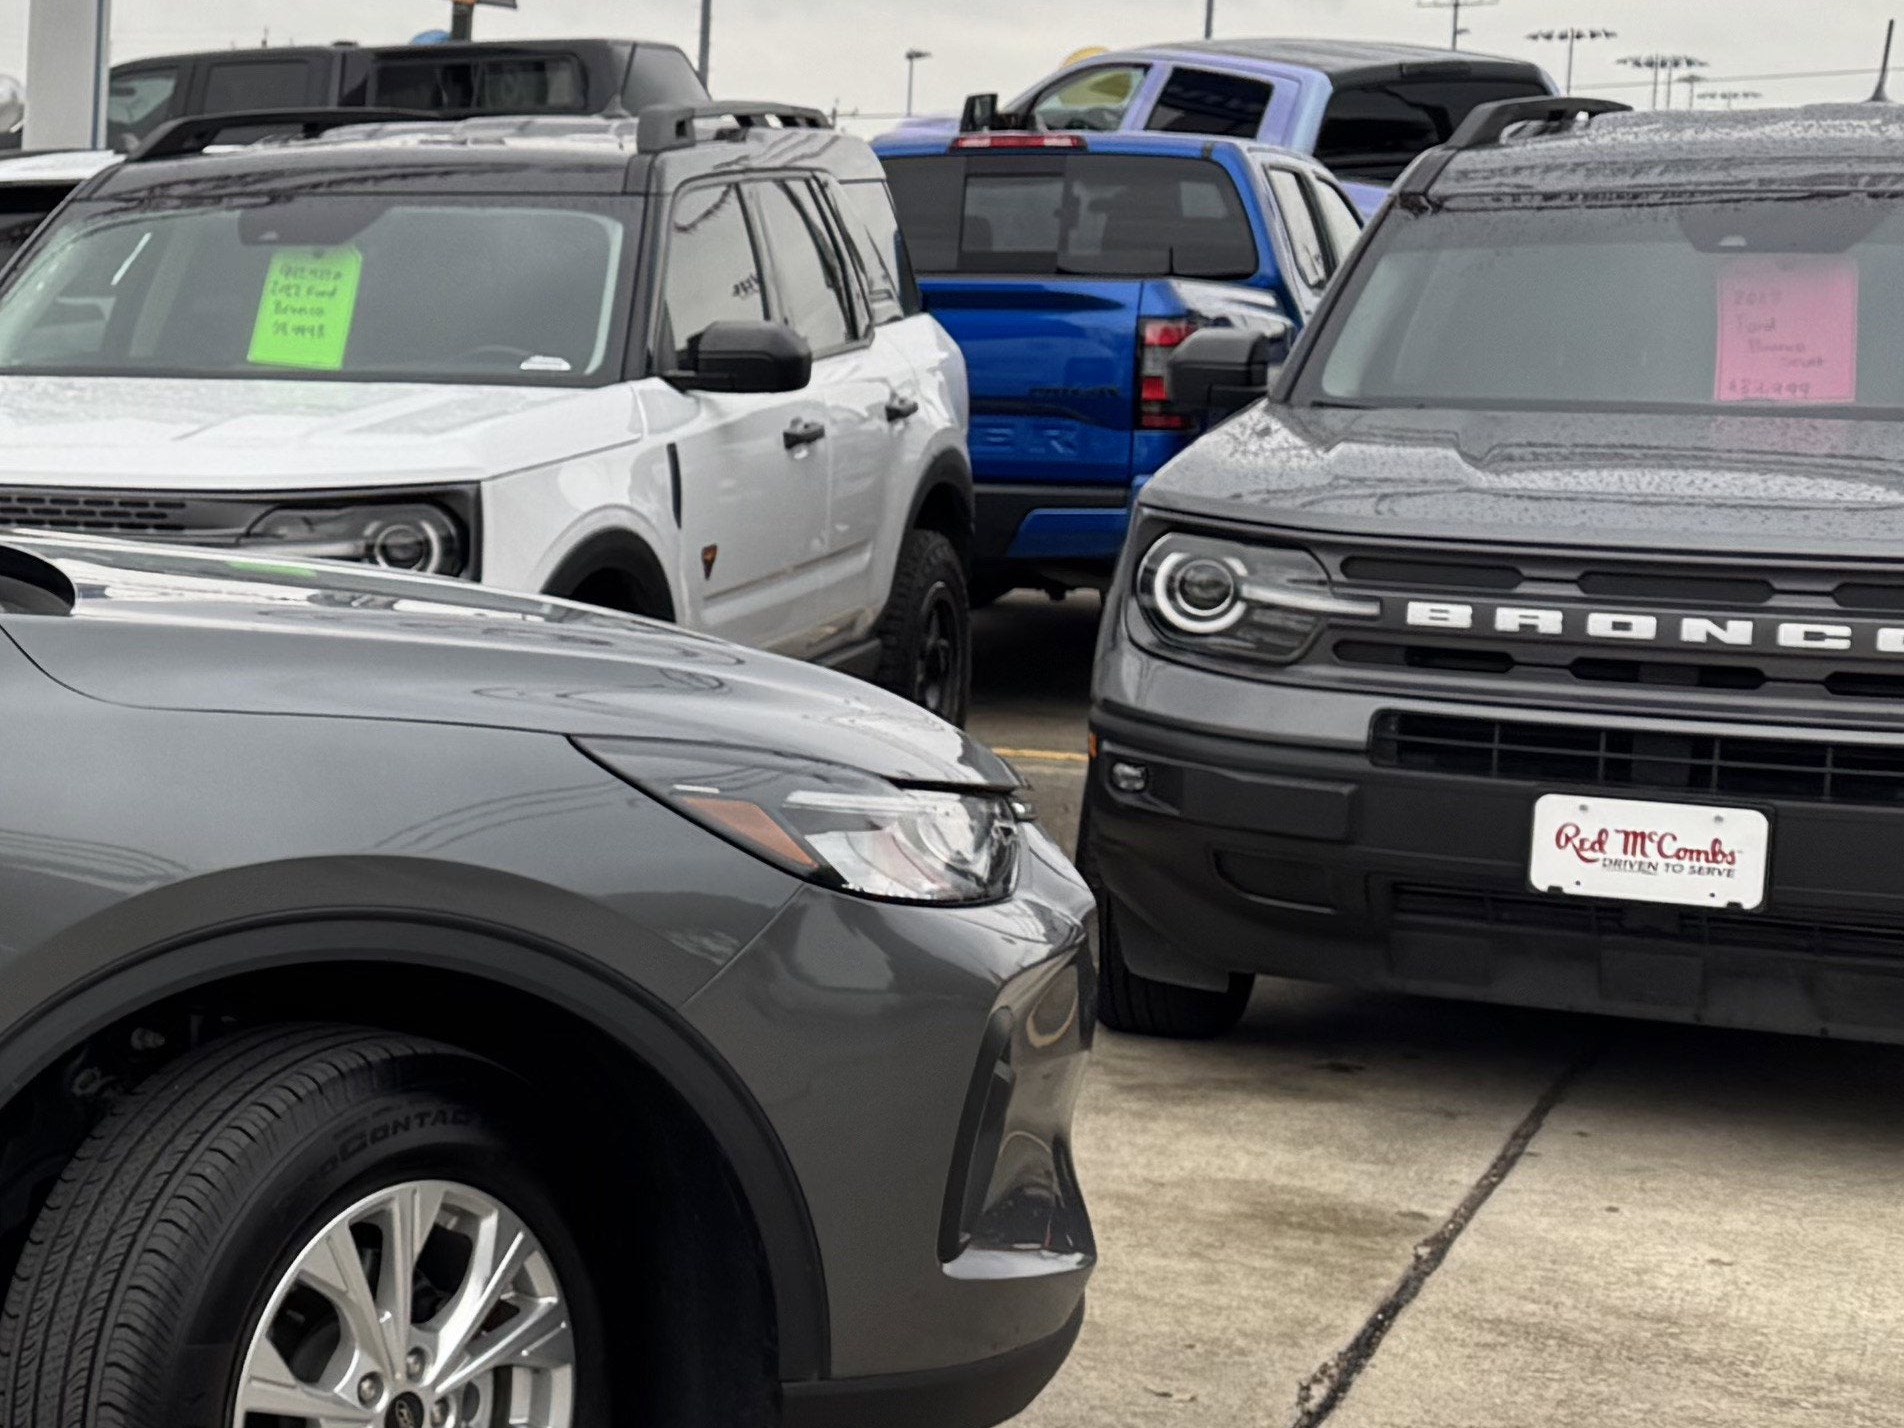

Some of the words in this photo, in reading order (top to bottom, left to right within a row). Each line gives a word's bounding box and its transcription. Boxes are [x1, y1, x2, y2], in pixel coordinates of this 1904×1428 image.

[1555, 822, 1609, 863] Red
[1614, 828, 1737, 865] McCombs
[1602, 857, 1659, 873] DRIVEN
[1664, 862, 1685, 875] TO
[1688, 865, 1736, 880] SERVE
